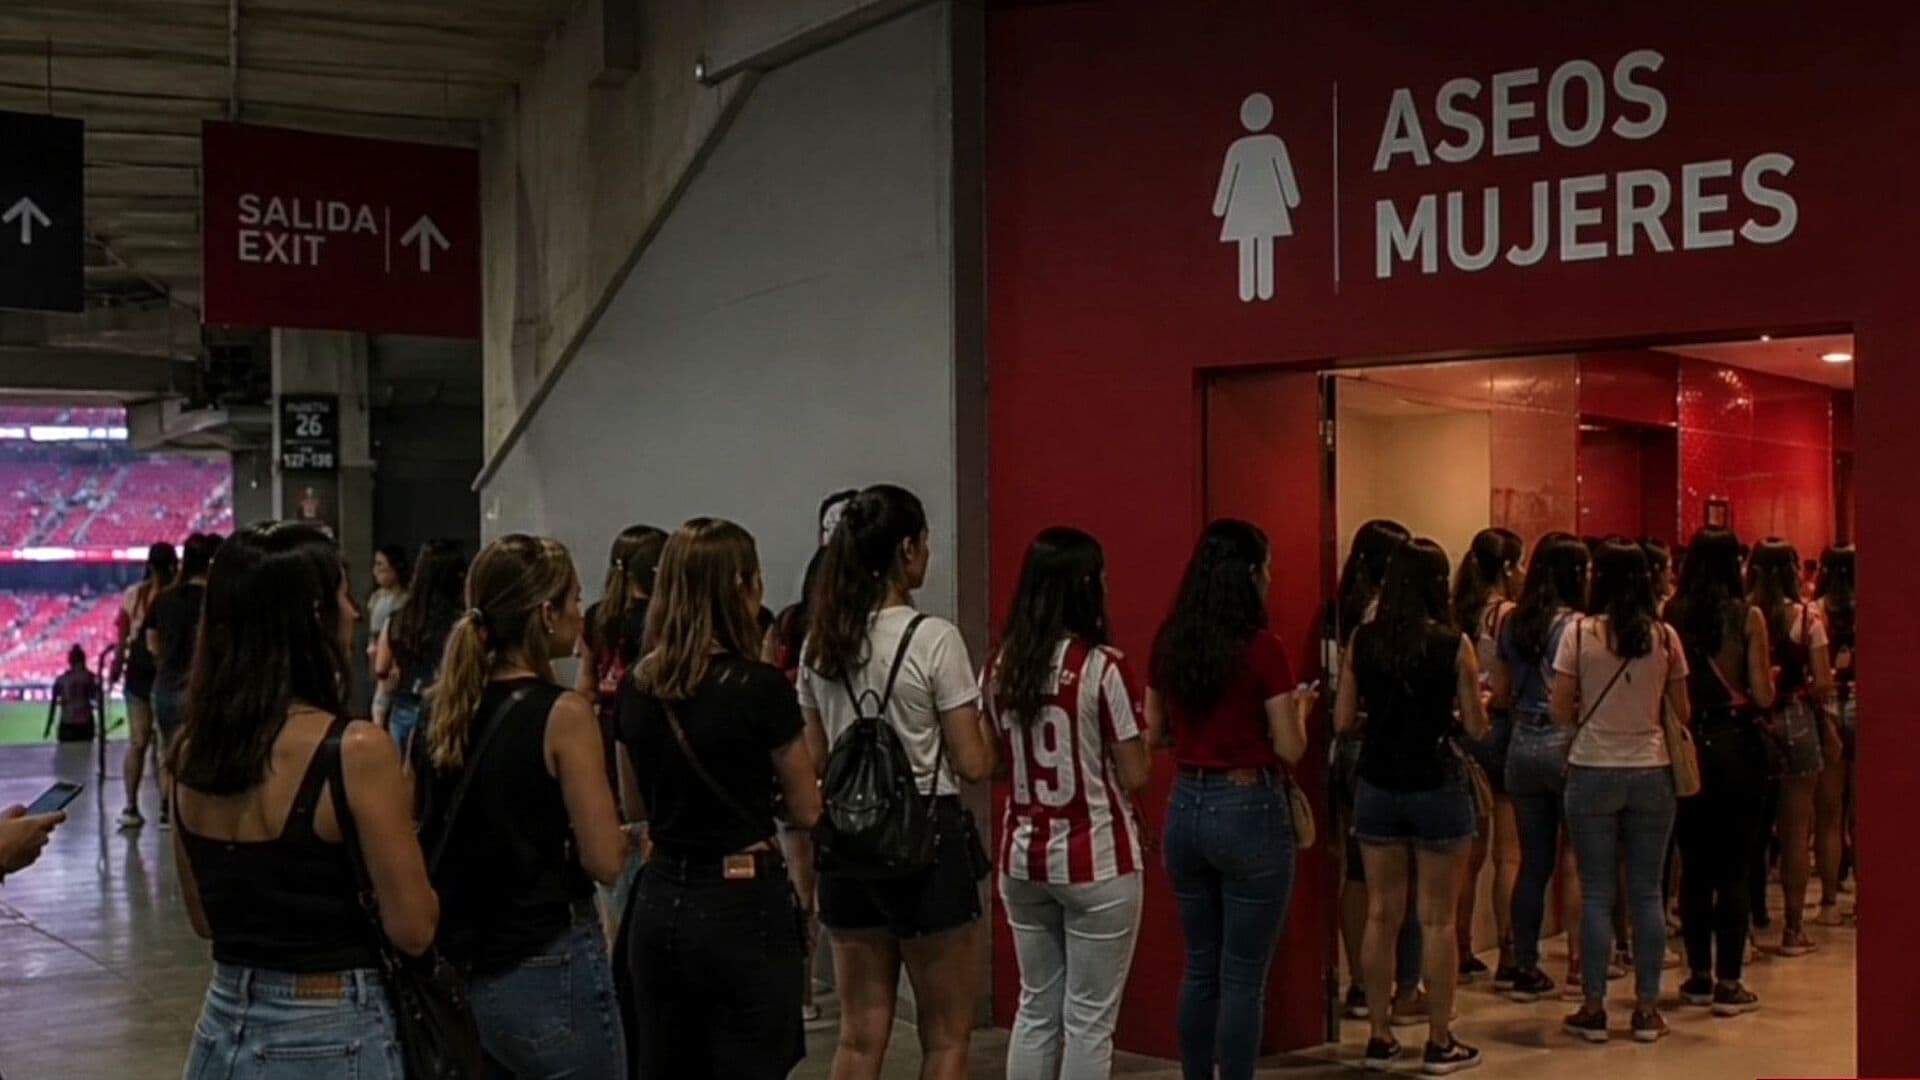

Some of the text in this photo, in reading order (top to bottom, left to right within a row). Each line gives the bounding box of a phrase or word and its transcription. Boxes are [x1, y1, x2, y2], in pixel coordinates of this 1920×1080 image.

[1373, 49, 1667, 172] ASEOS
[238, 193, 378, 235] SALIDA
[238, 230, 326, 266] EXIT
[1375, 153, 1798, 278] MUJERES
[295, 413, 324, 438] 26
[1001, 704, 1077, 807] 19
